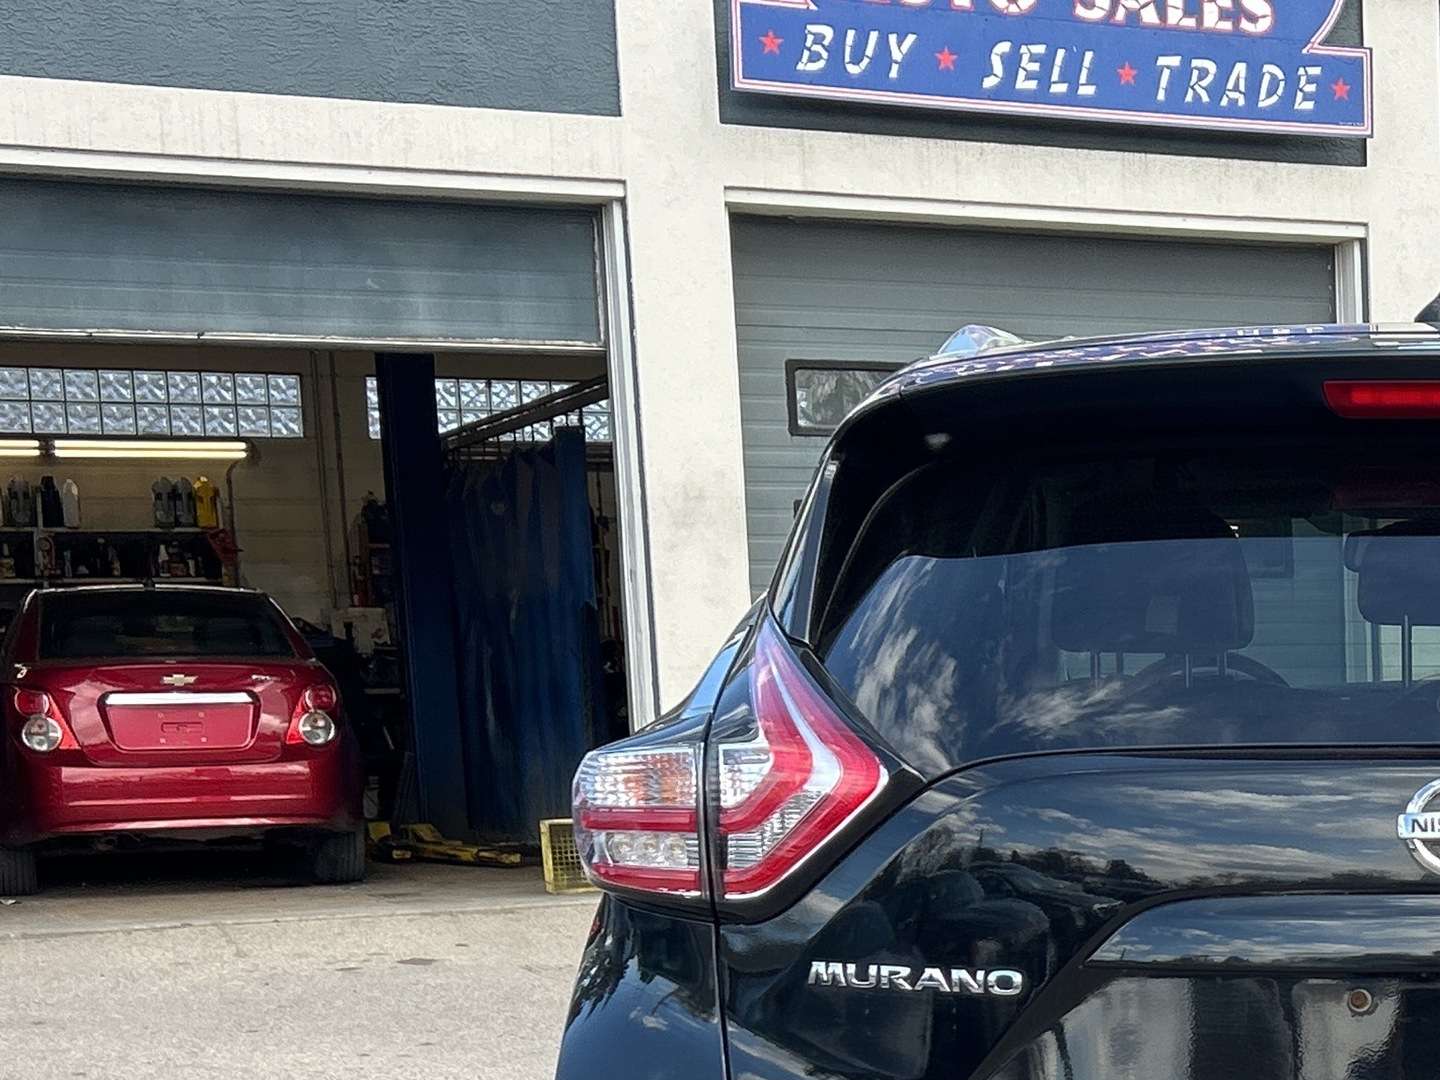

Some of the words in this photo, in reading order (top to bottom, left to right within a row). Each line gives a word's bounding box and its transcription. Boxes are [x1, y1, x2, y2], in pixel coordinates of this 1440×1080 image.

[796, 23, 918, 79] BUY
[982, 41, 1096, 95] SELL
[1155, 55, 1322, 110] TRADE
[808, 961, 1023, 996] MURANO
